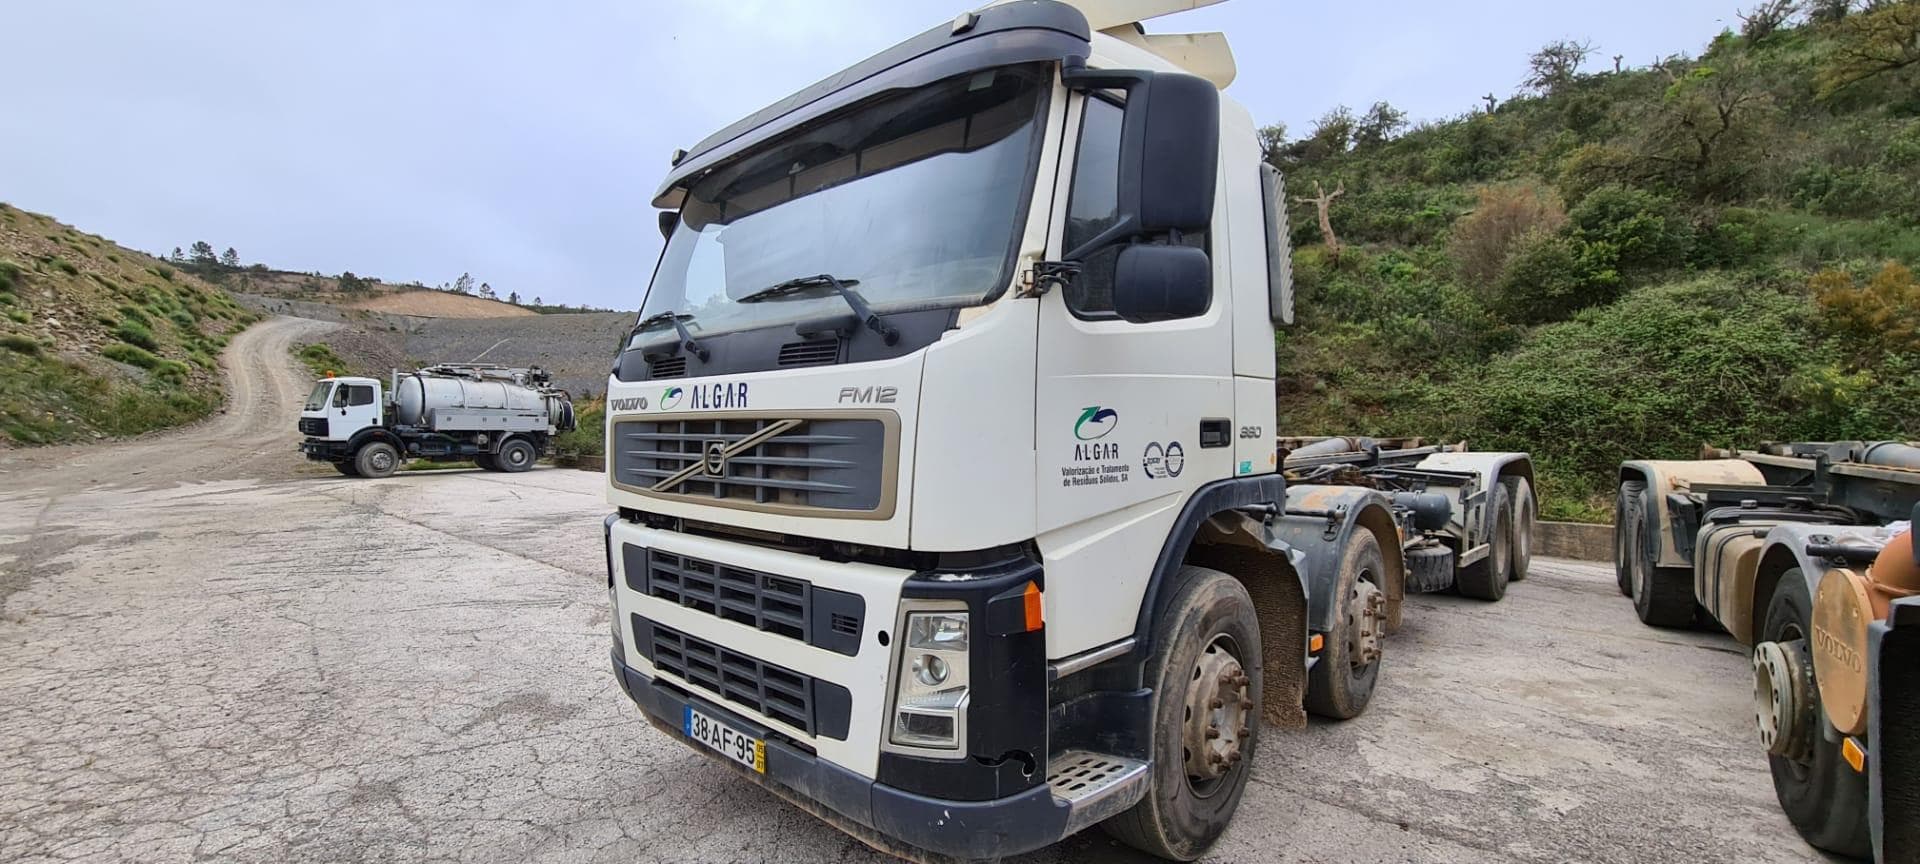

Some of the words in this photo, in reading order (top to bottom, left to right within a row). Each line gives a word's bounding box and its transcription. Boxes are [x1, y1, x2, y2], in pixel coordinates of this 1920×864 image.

[690, 382, 748, 409] ALGAR
[838, 385, 898, 403] FM12
[611, 397, 648, 410] VOLVO
[1074, 443, 1119, 461] ALGAR
[1101, 464, 1130, 473] Tratamento
[1063, 478, 1071, 487] de
[1815, 625, 1861, 673] VOLVO
